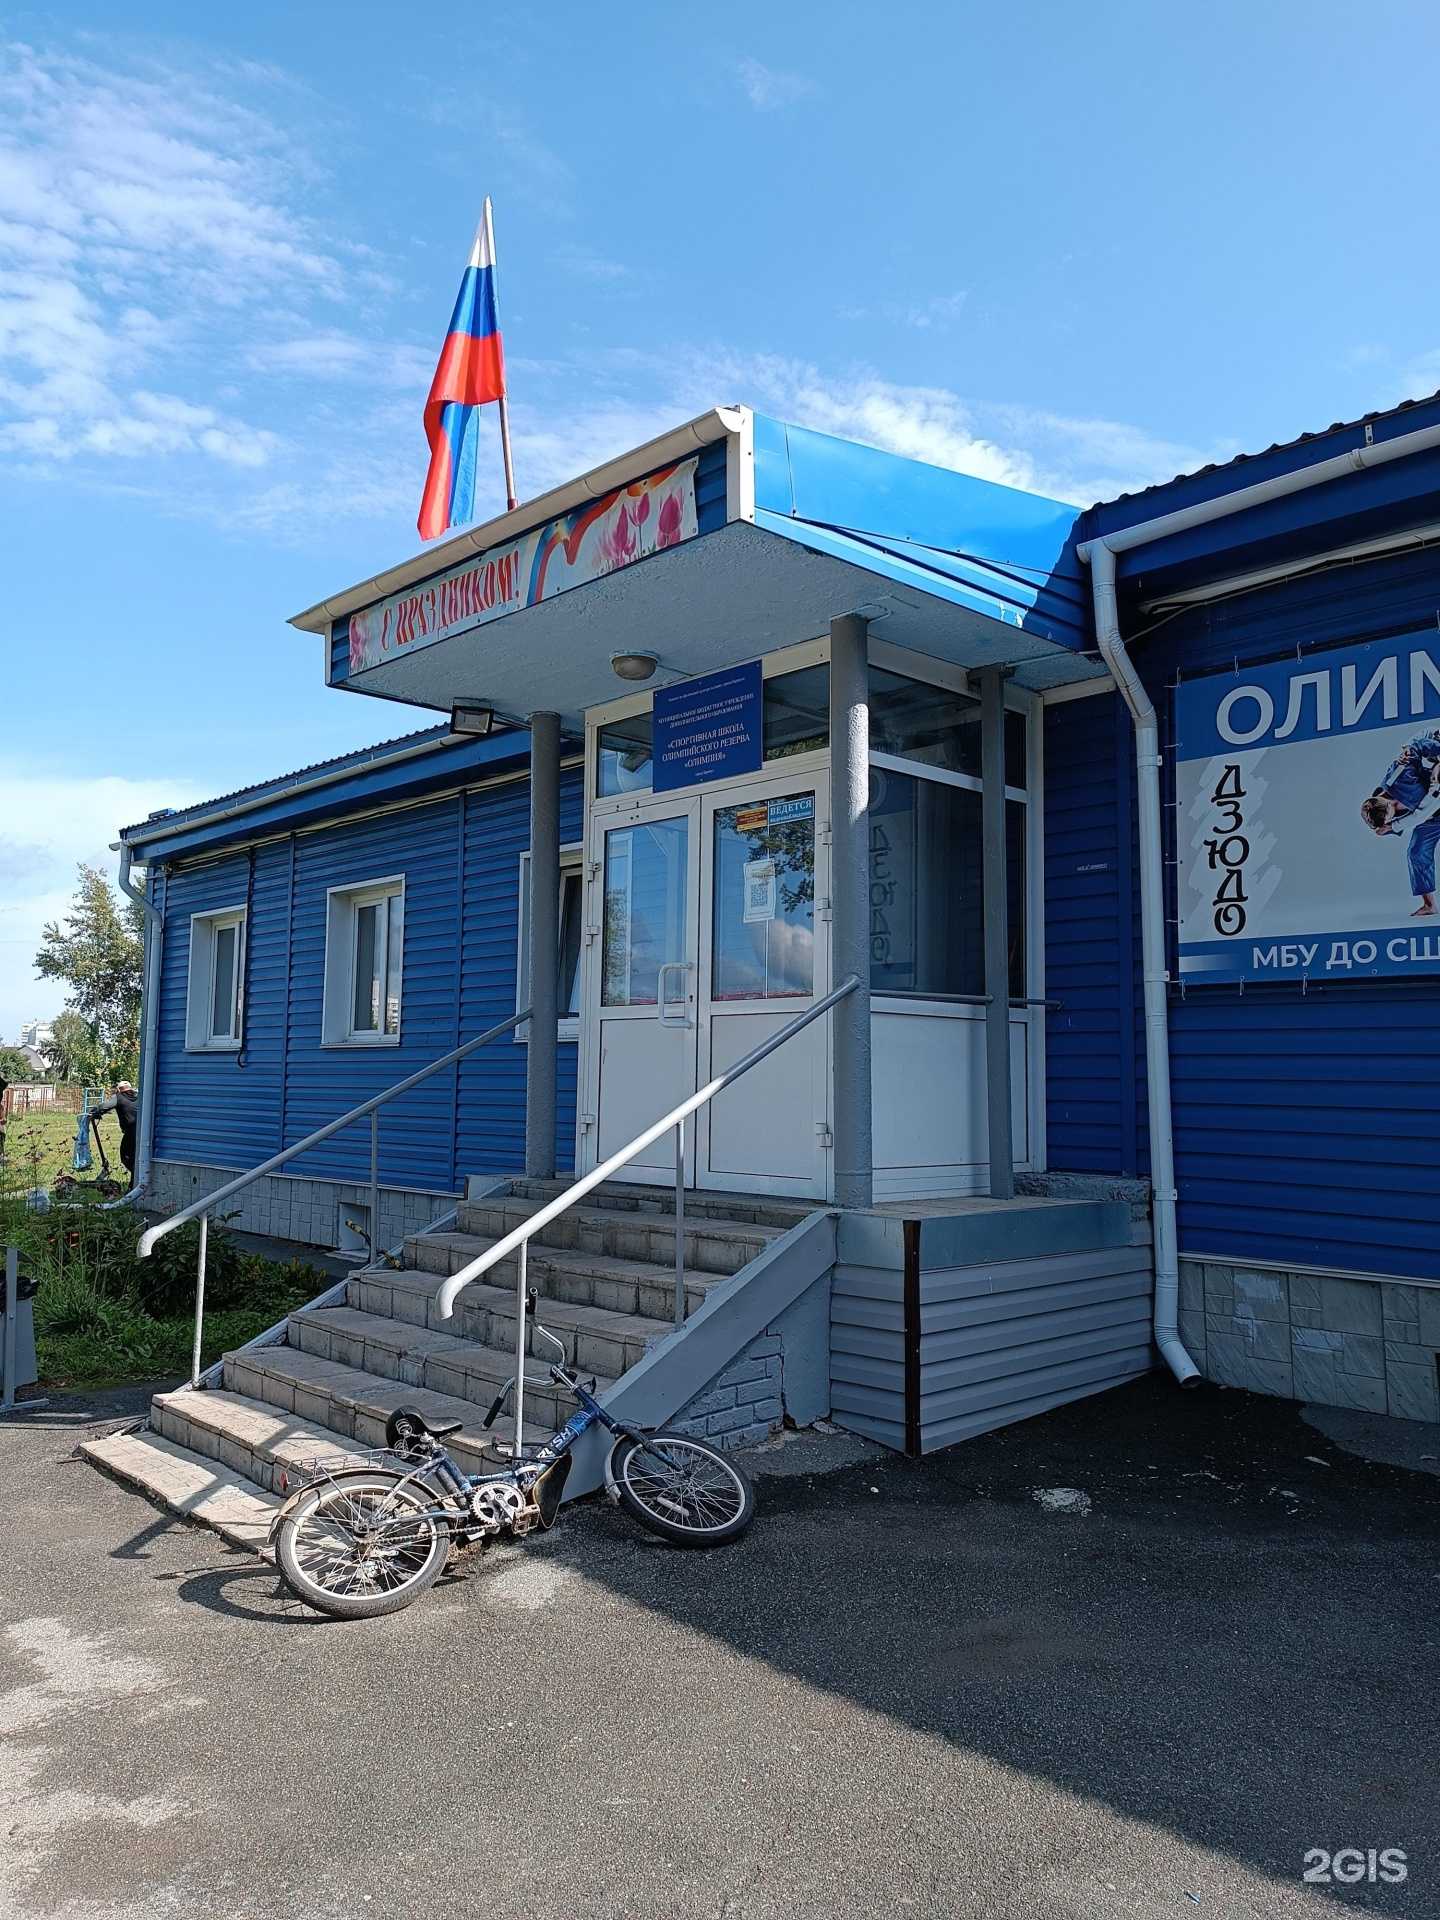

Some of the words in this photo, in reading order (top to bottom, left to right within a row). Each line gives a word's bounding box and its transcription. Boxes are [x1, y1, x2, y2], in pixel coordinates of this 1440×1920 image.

[381, 608, 393, 652] С
[396, 550, 520, 645] ПРАЗДНИКОМ!
[718, 722, 745, 737] ШКОЛА
[662, 741, 719, 762] ОЛИМПИЙСКОГО
[720, 733, 751, 748] РЕЗЕРВА
[770, 799, 812, 816] ВЕДЕТСЯ
[1204, 764, 1250, 937] ДЗЮДО
[1253, 943, 1319, 969] МБУ
[1326, 940, 1377, 970] ДО
